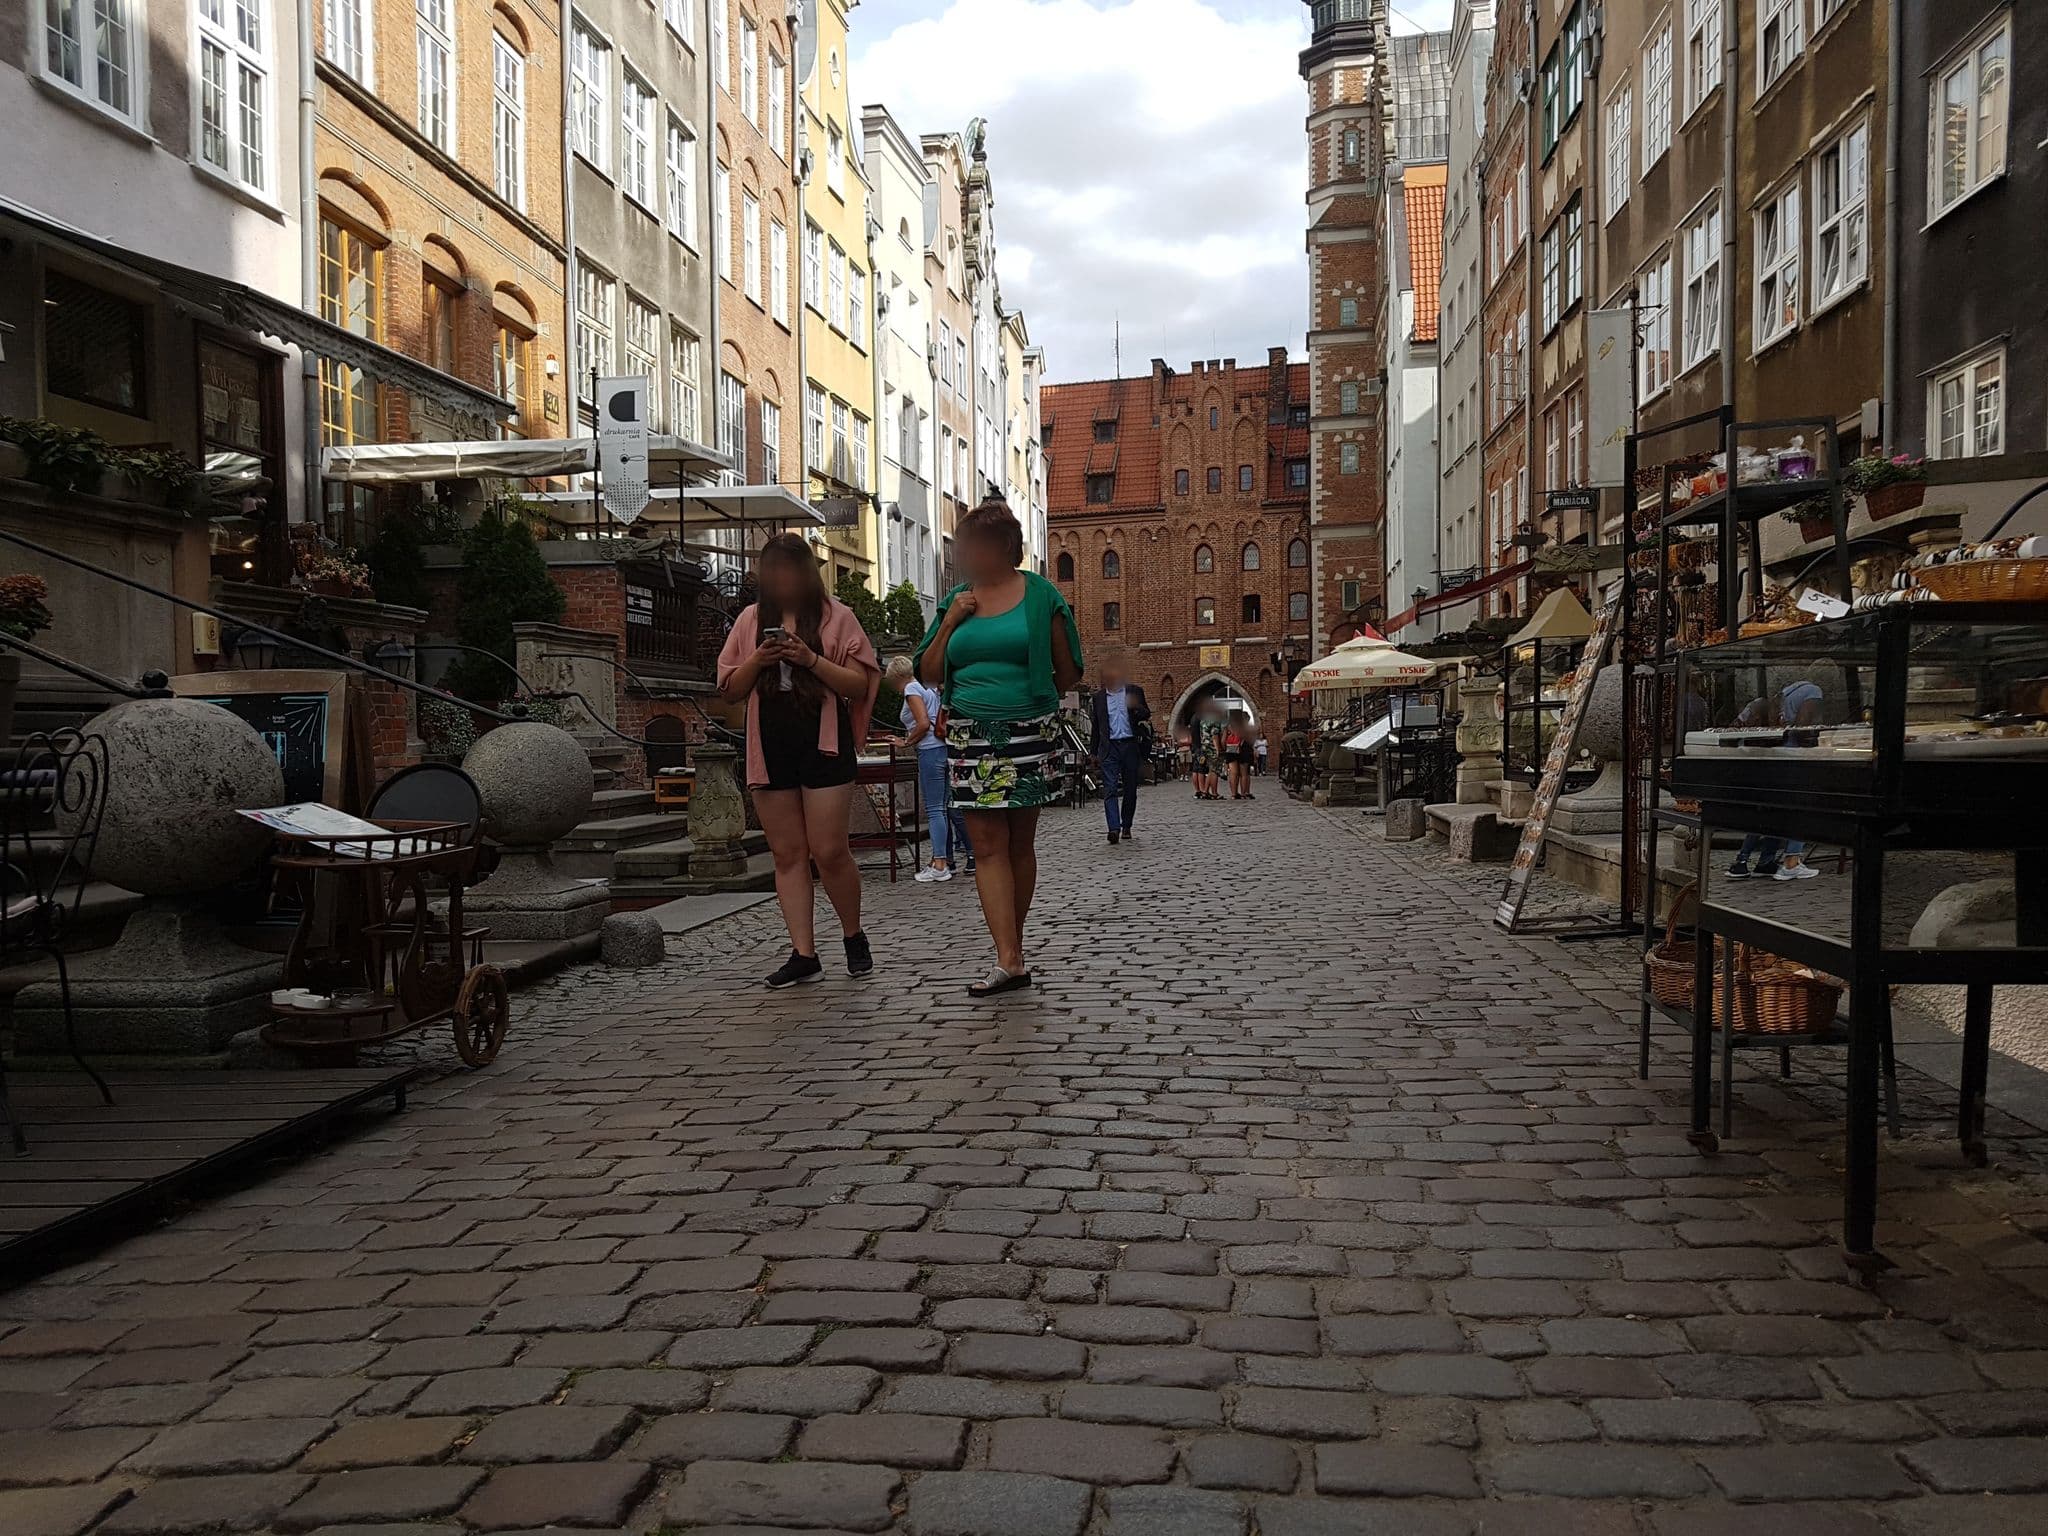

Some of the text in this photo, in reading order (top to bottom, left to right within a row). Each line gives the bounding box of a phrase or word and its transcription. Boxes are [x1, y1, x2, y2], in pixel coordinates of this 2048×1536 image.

[605, 428, 640, 436] drukarnia
[1553, 496, 1590, 506] MARIACKA
[1808, 592, 1824, 602] 5
[1312, 666, 1428, 678] TYSKIE TYSKIE
